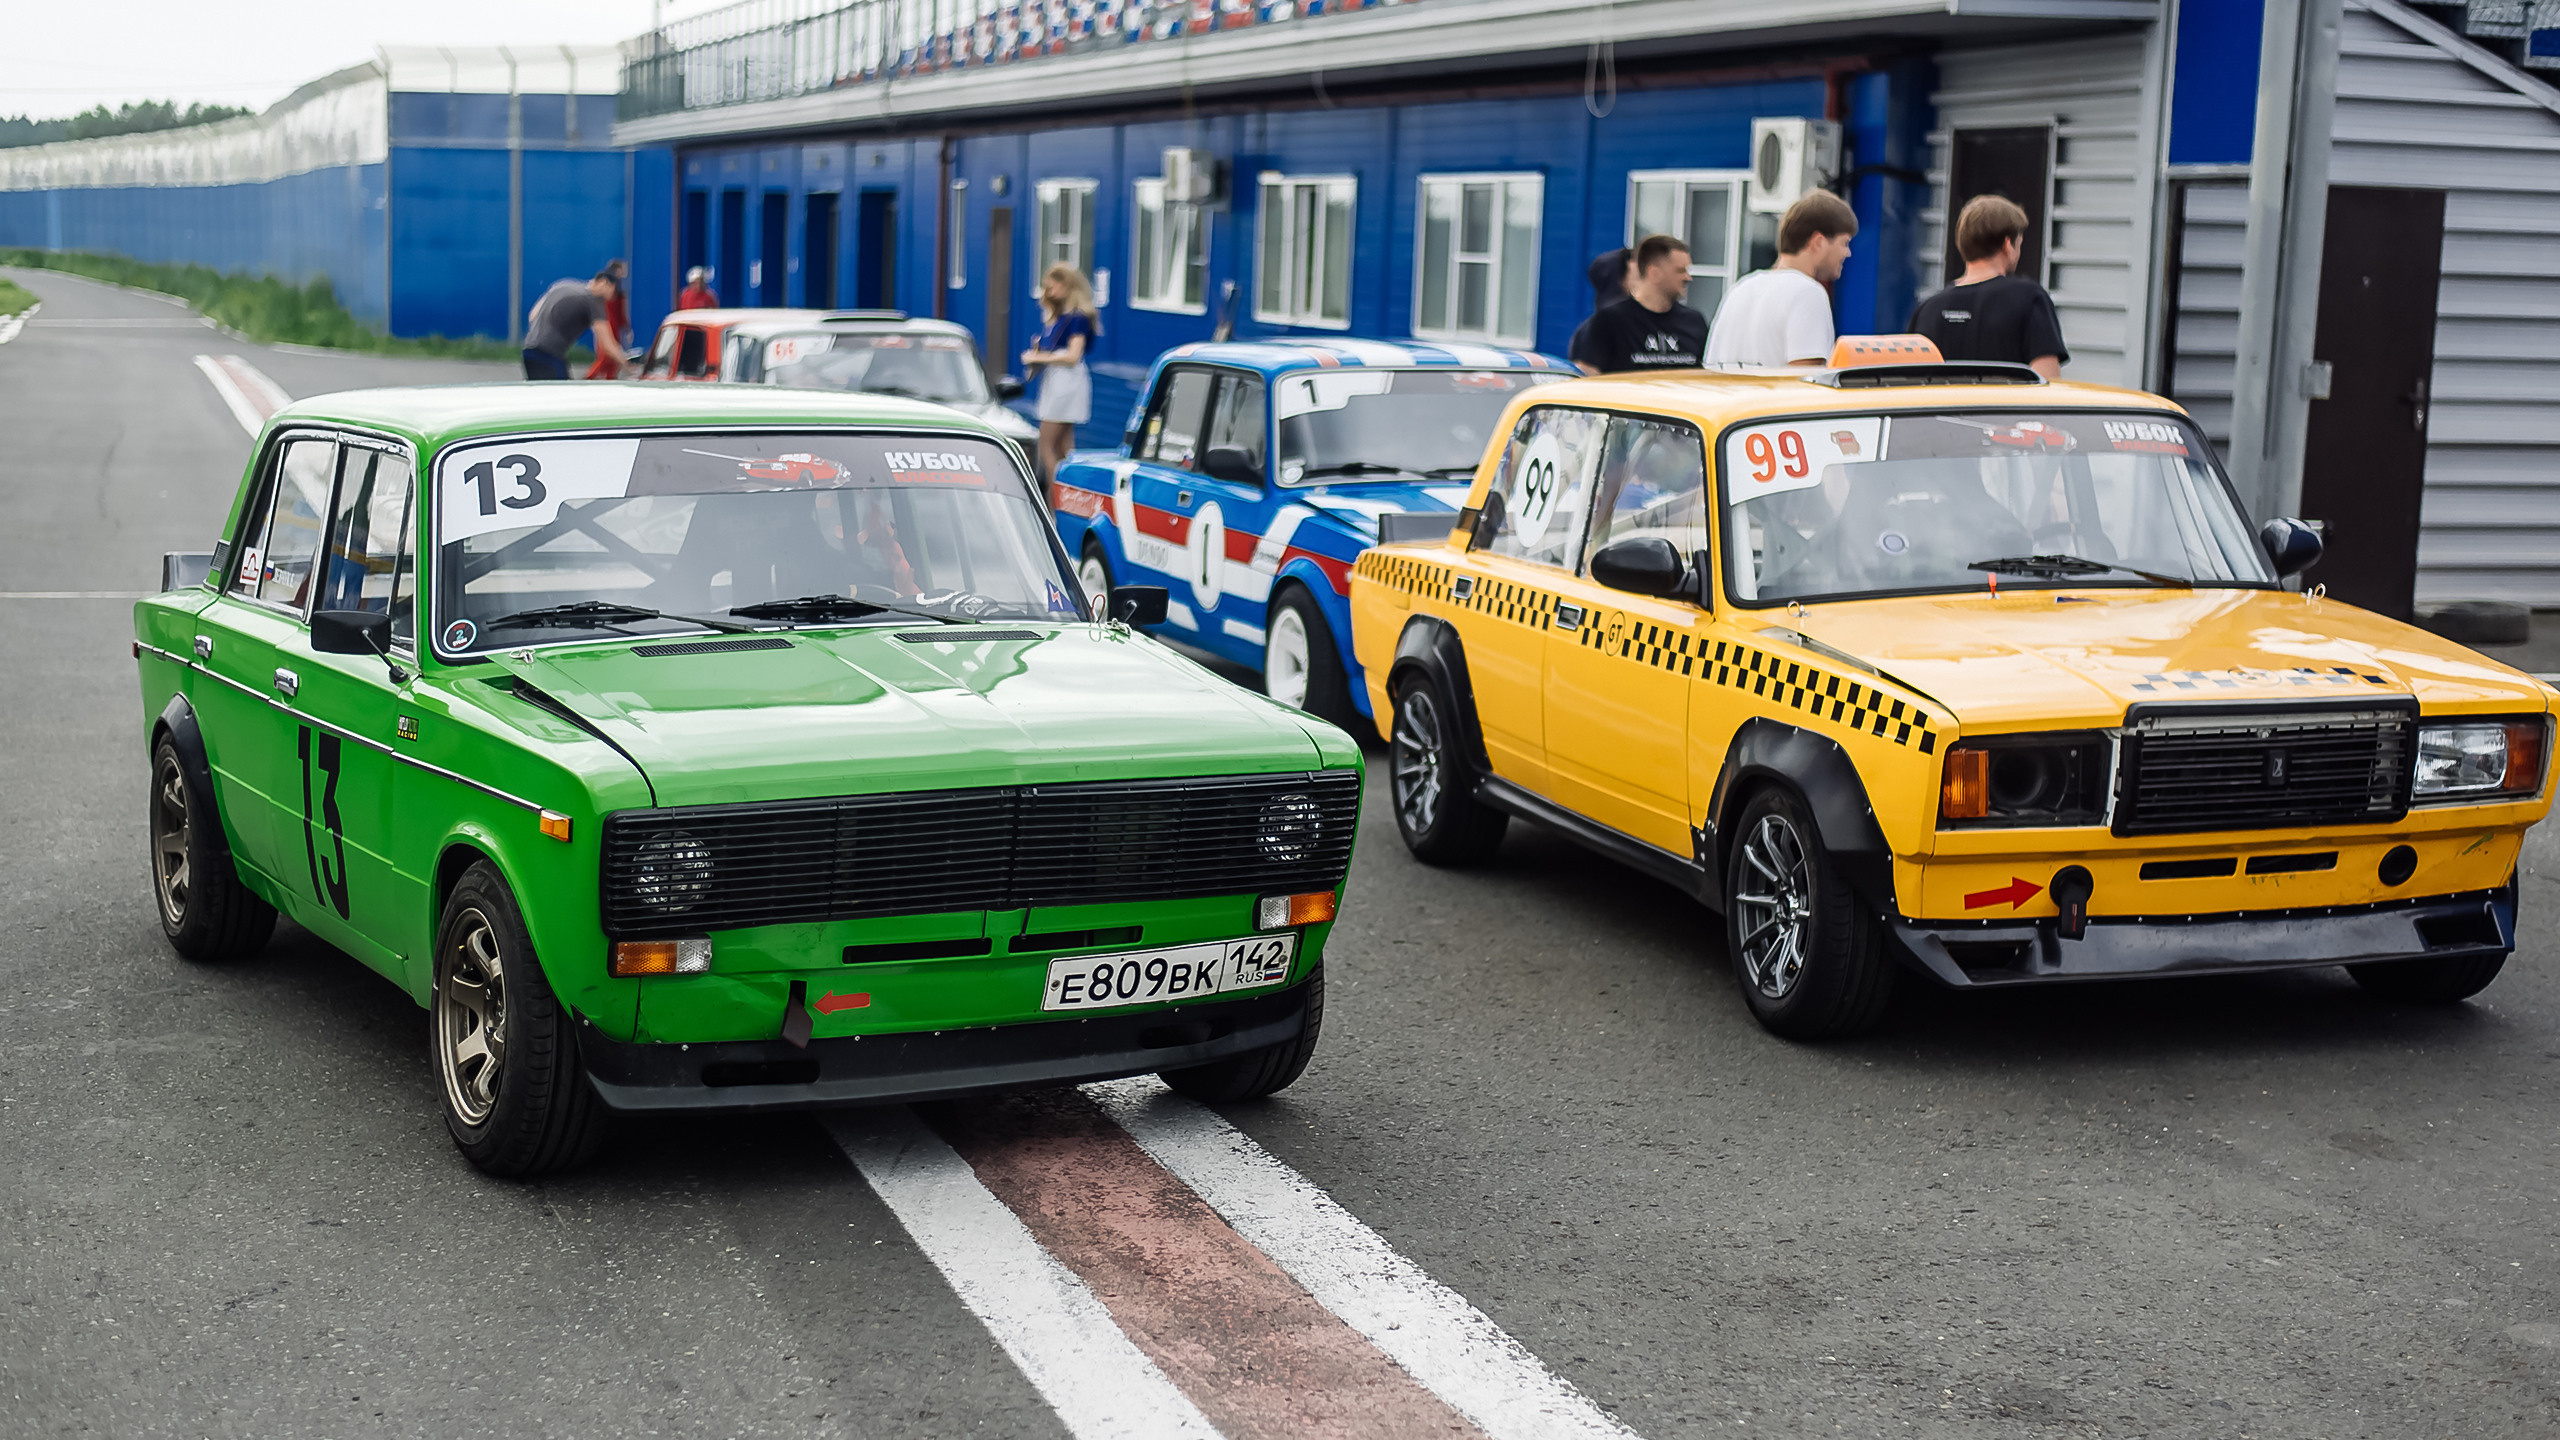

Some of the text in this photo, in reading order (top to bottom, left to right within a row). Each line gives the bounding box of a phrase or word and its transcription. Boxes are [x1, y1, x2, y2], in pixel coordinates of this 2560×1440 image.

[1301, 379, 1317, 404] 1
[1745, 430, 1809, 483] 99
[2102, 421, 2185, 446] КУБОК
[463, 454, 547, 516] 13
[883, 452, 982, 472] КУБОК
[1522, 457, 1554, 522] 99
[1201, 523, 1210, 587] 1
[1608, 624, 1623, 643] GT
[298, 724, 350, 921] 13
[1059, 941, 1284, 1004] Е809ВК 142
[1235, 970, 1263, 985] RUS
